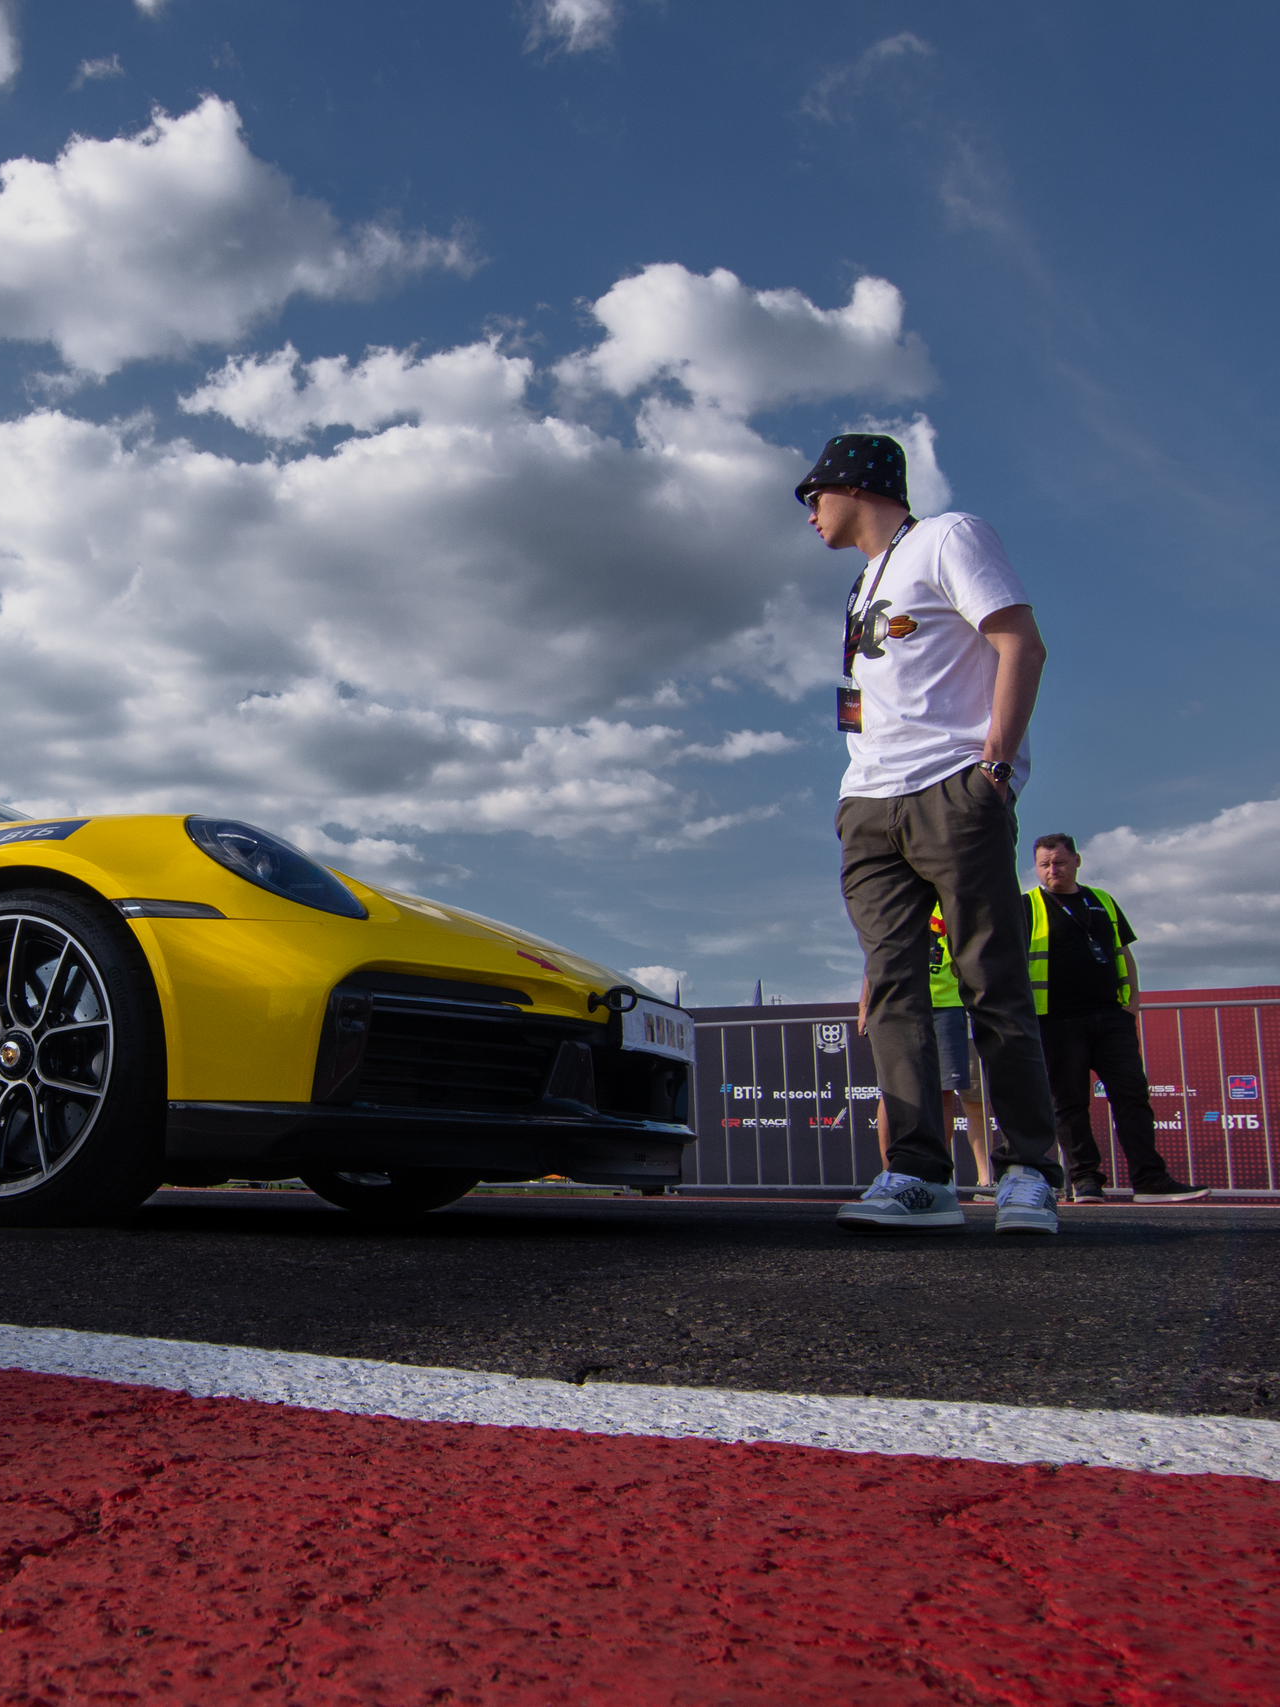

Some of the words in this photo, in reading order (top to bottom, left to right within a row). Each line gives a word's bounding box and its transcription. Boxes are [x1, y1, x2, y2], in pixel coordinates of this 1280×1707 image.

[734, 1086, 762, 1099] ВТБ
[773, 1091, 831, 1099] ROSGONKI
[1221, 1114, 1260, 1129] ВТБ
